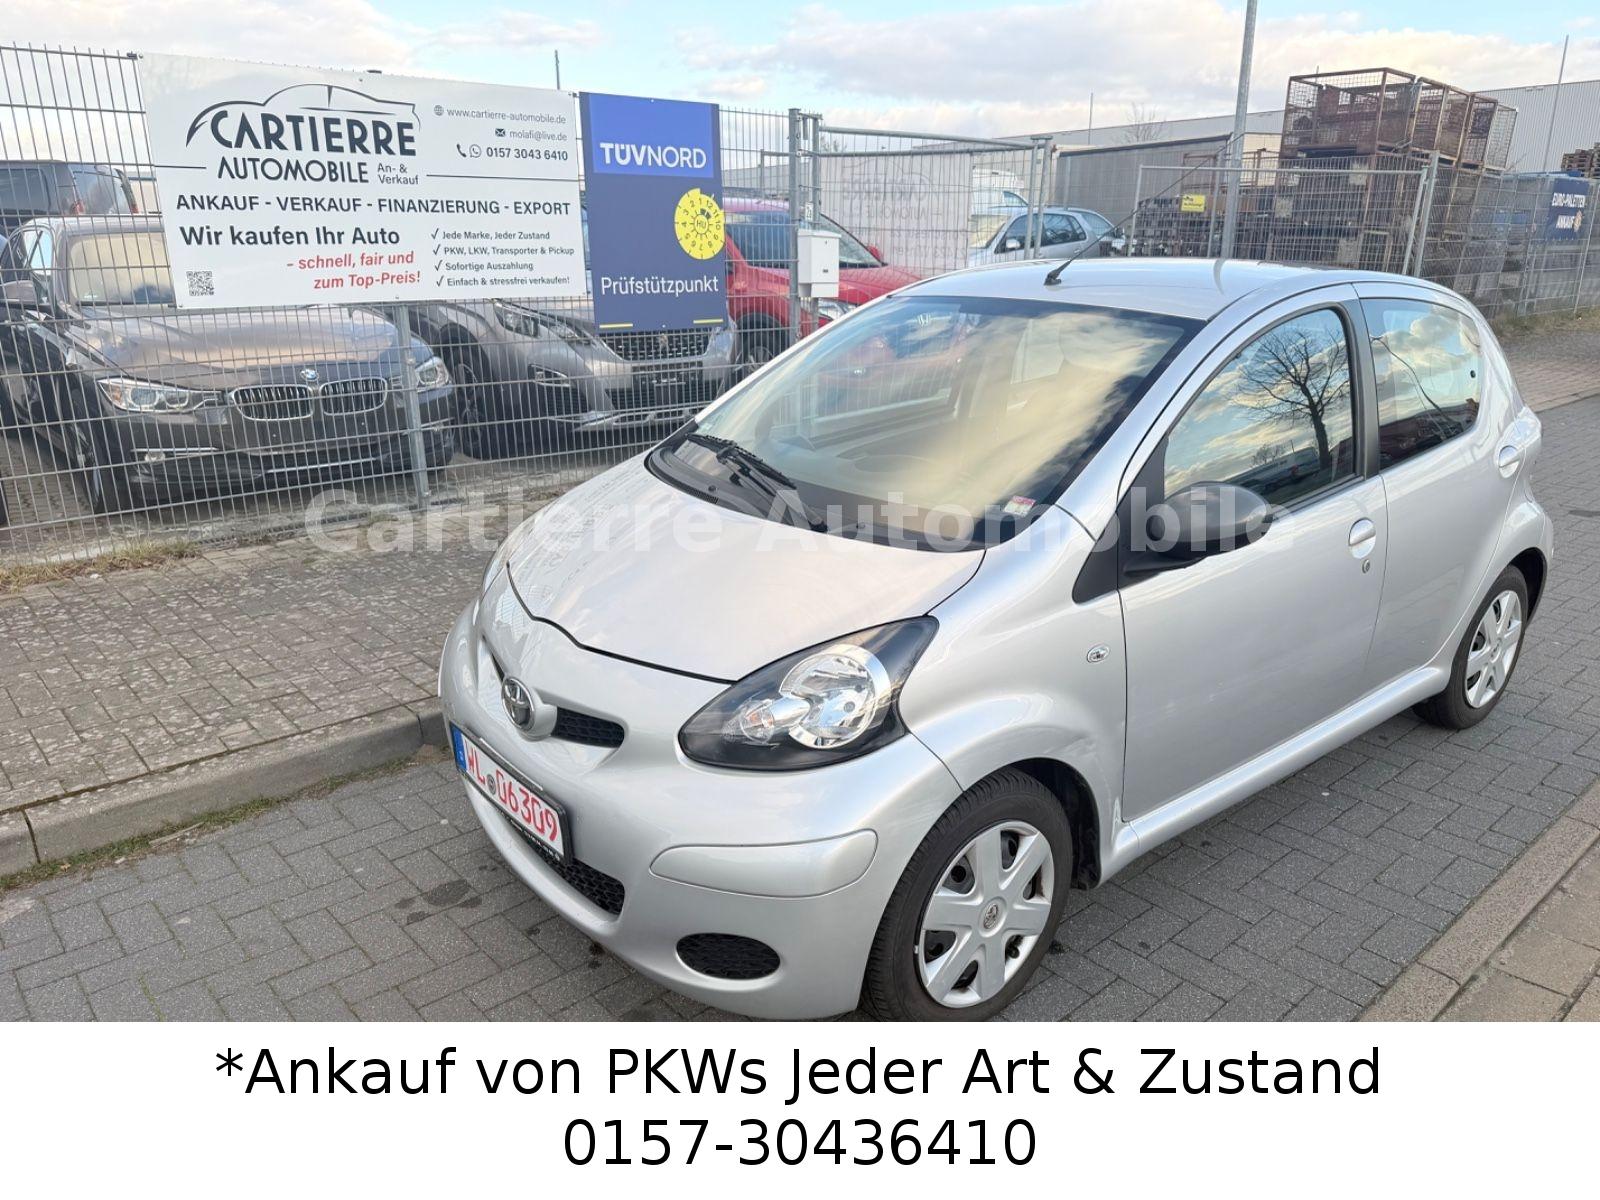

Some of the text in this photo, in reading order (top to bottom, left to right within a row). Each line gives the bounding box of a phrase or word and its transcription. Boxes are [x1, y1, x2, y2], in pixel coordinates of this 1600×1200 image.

[446, 107, 567, 125] www.cartierre-automobile.de
[210, 110, 417, 157] CARTIERRE
[486, 147, 569, 161] 0157 3043 6410
[217, 156, 369, 183] AUTOMOBILE
[377, 162, 408, 174] An- &
[378, 174, 419, 186] Verkauf
[176, 194, 260, 211] ANKAUF
[276, 196, 362, 213] VERKAUF
[378, 198, 501, 215] FINANZIERUNG
[514, 201, 571, 216] EXPORT
[180, 226, 400, 246] Wir kaufen Ihr Auto
[442, 230, 551, 242] Jede Marke, Jeder Zustand
[298, 254, 358, 271] schnell,
[360, 252, 384, 268] fair
[388, 251, 414, 267] und
[444, 246, 575, 257] PKW, LKW, Transporter & Pickup
[445, 261, 535, 273] Sofortige Auszahlung
[313, 270, 421, 290] zum Top-Preis!
[446, 275, 571, 288] Einfach & stressfrei verkaufen!
[600, 275, 720, 297] Prüfstützpunkt
[465, 738, 486, 786] WL
